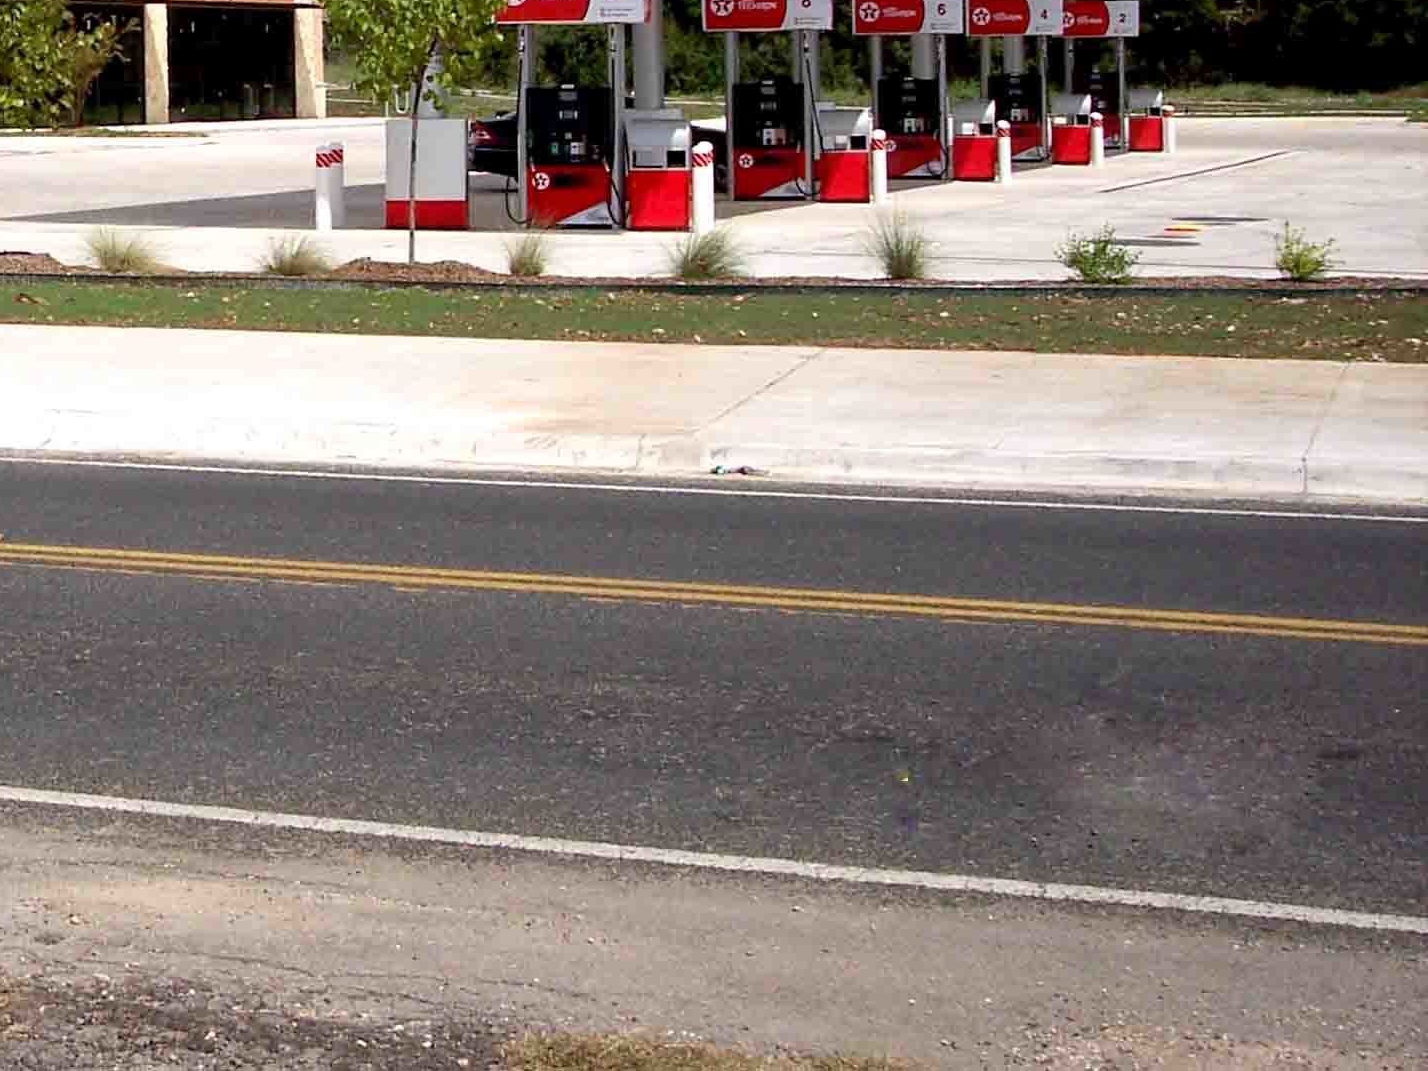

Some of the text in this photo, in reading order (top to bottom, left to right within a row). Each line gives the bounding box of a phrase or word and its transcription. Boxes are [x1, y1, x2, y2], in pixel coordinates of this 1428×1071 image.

[937, 3, 947, 16] 6
[1040, 9, 1048, 20] 4
[1119, 13, 1127, 24] 2
